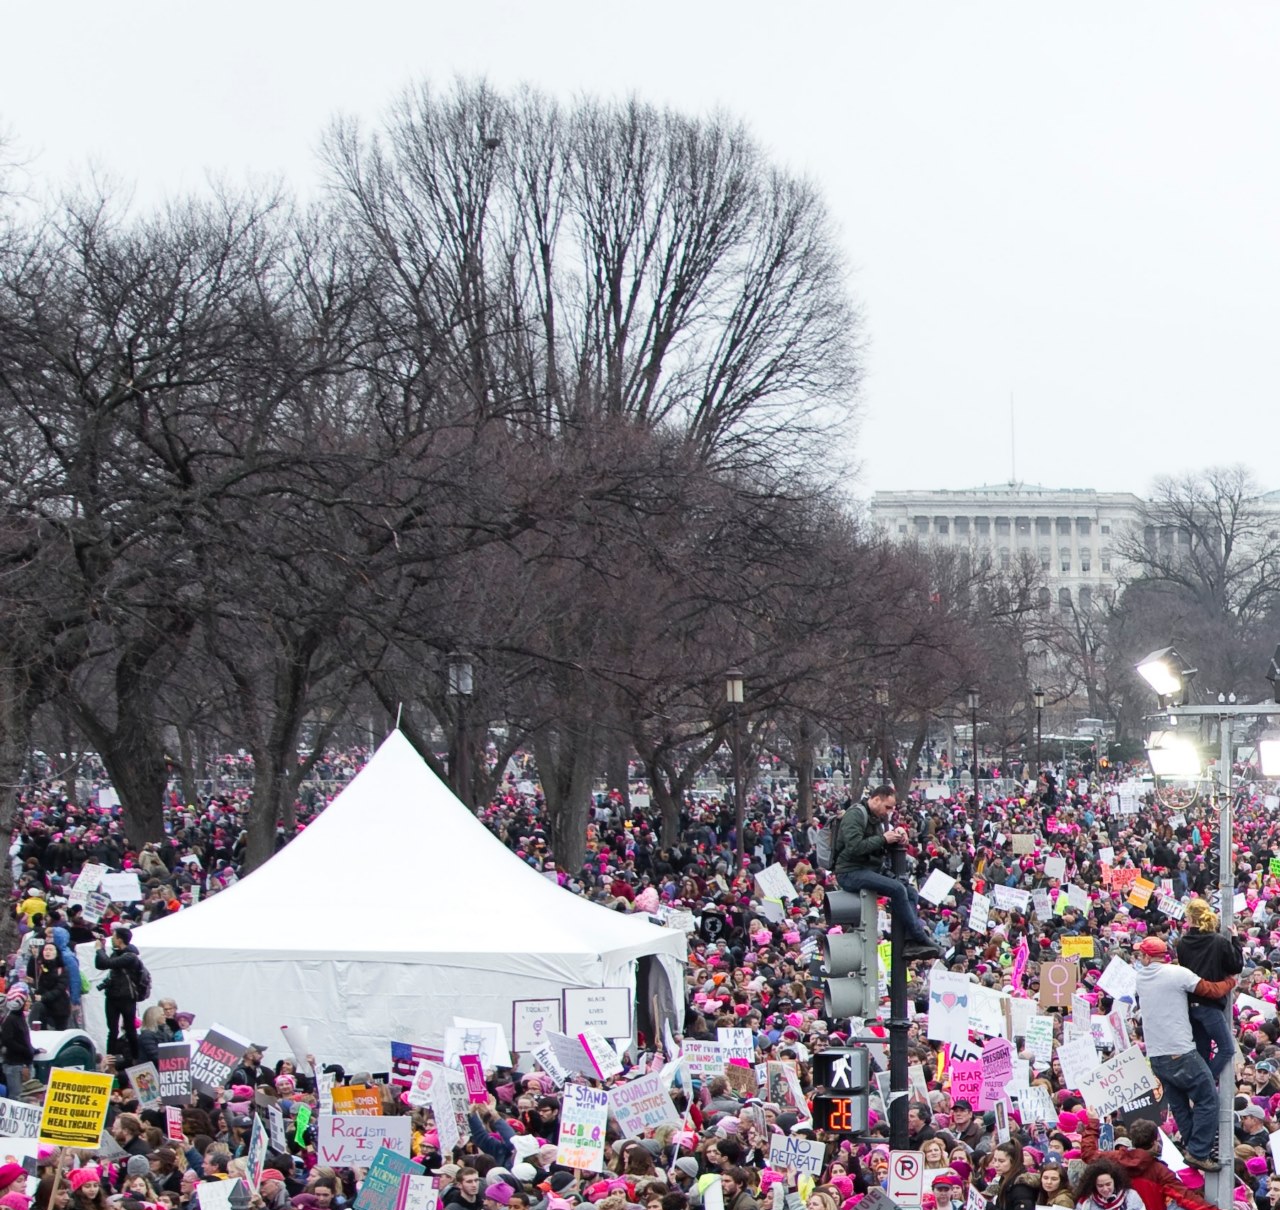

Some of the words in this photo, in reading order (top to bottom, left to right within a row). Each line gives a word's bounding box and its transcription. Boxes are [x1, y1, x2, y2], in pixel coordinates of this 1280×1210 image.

[159, 1058, 188, 1070] NASTY
[159, 1070, 189, 1083] NEVER
[51, 1081, 106, 1095] REPRODUCTIVE
[160, 1084, 190, 1096] QUITS.
[611, 1077, 660, 1107] EQUALITY
[53, 1092, 88, 1105] JUSTICE
[615, 1106, 630, 1118] AND
[631, 1093, 664, 1115] JUSTICE
[49, 1106, 67, 1116] FREE
[70, 1108, 101, 1119] QUALITY
[48, 1118, 97, 1130] HEALTHCARE
[626, 1116, 643, 1132] FOR
[644, 1110, 668, 1126] ALL!
[786, 1137, 811, 1152] NO
[770, 1148, 821, 1171] RETREAT
